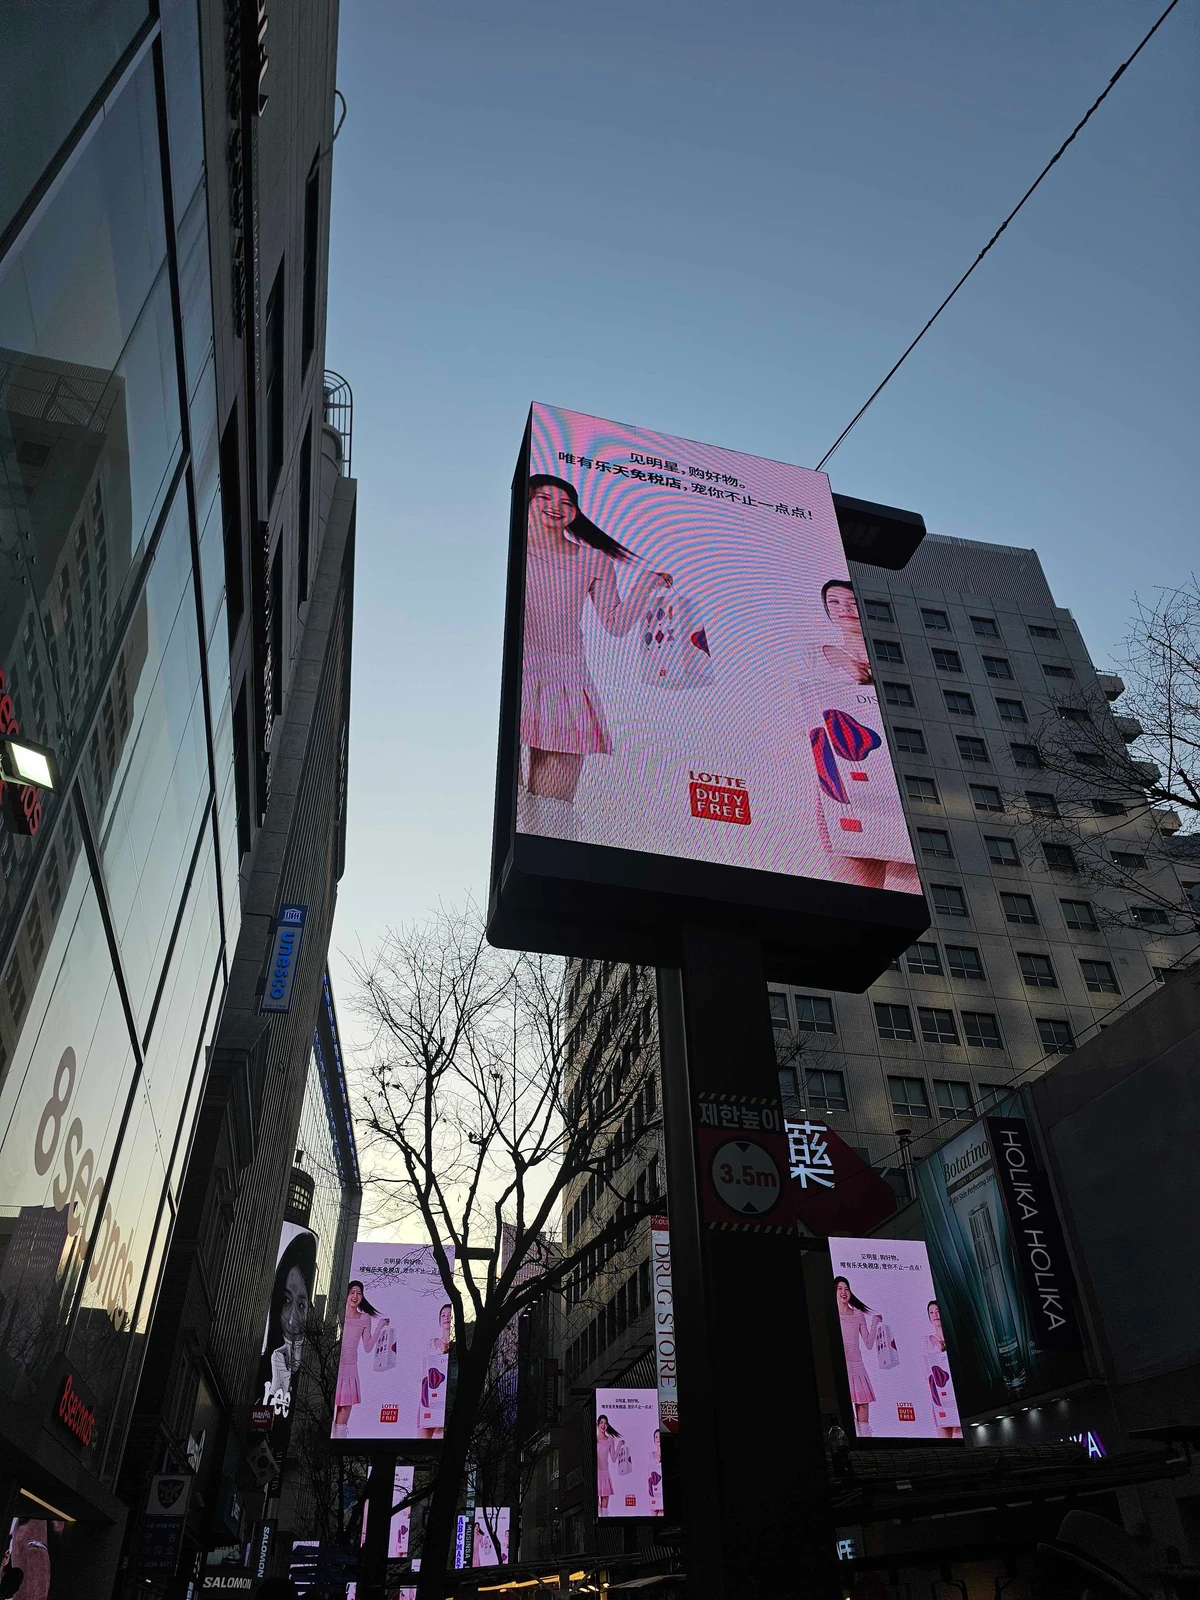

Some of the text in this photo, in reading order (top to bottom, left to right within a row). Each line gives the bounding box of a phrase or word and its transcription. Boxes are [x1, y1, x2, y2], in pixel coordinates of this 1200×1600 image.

[630, 452, 746, 490] 见明星，购好物。
[689, 770, 747, 789] LOTTE
[696, 788, 744, 806] DUTY
[697, 801, 745, 819] FREE
[269, 931, 296, 1000] unesco
[699, 1102, 781, 1132] 제한높이
[719, 1162, 777, 1188] 3.5m
[943, 1140, 988, 1184] Botatíno
[1000, 1129, 1067, 1331] HOLIKA HOLIKA
[654, 1243, 673, 1306] DRUG
[656, 1311, 677, 1389] STORE
[257, 1526, 271, 1578] SALOMON
[464, 1524, 473, 1559] MUSINSA
[202, 1576, 253, 1590] SALOMON
